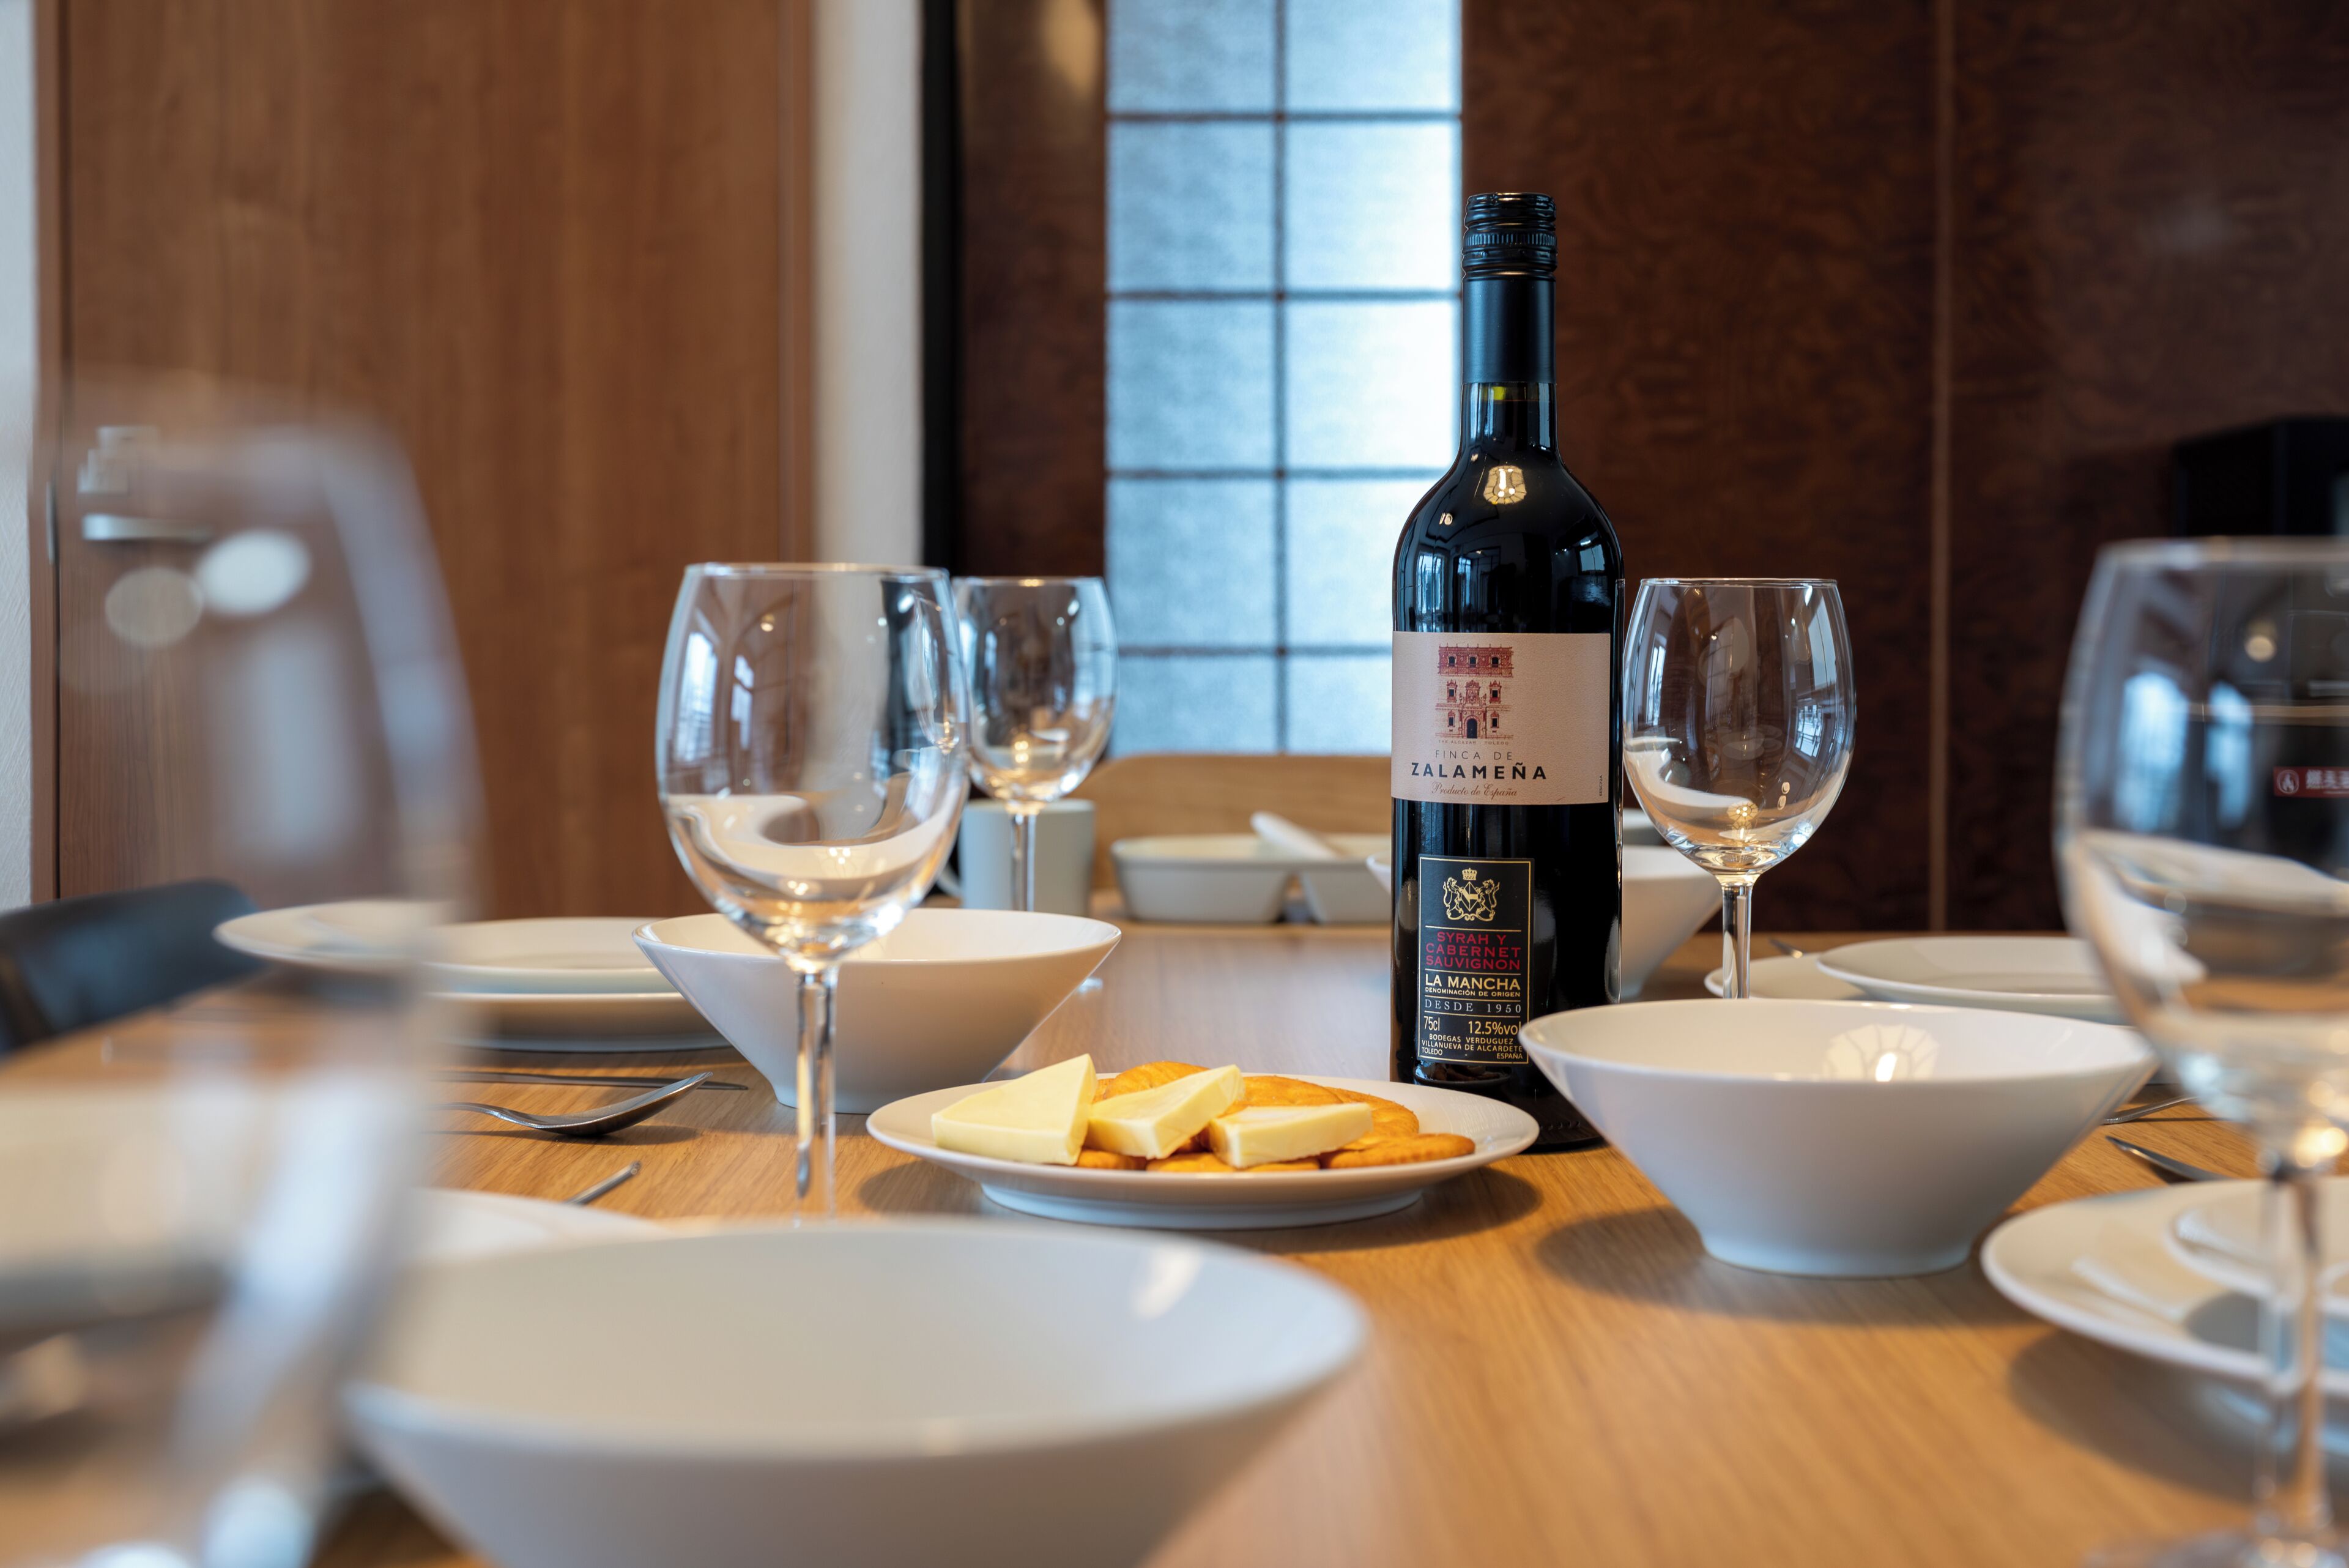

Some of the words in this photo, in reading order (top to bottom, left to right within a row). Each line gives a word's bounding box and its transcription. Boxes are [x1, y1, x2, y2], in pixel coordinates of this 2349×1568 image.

[1435, 750, 1480, 759] FINCA
[1494, 751, 1512, 760] DE
[1411, 762, 1546, 779] ZALAMEÑA
[1431, 782, 1469, 794] Producto
[1483, 784, 1518, 800] España
[1438, 932, 1488, 945] SYRAH
[1496, 934, 1507, 945] Y
[1426, 943, 1521, 958] CABERNET
[1426, 955, 1520, 970] SAUVIGNON
[1425, 973, 1442, 986] LA
[1448, 976, 1521, 990] MANCHA
[1425, 987, 1475, 996] DENOMINACIÓN
[1425, 999, 1474, 1012] DESDE
[1487, 1004, 1521, 1013] 1950
[1423, 1016, 1440, 1031] 75cl
[1468, 1021, 1521, 1035] 12.5%vol
[1422, 1040, 1461, 1050] VILLANUEVA
[1429, 1034, 1461, 1042] BODEGAS
[1466, 1036, 1513, 1045] VERDUGUEZ
[1422, 1047, 1443, 1055] TOLEDO
